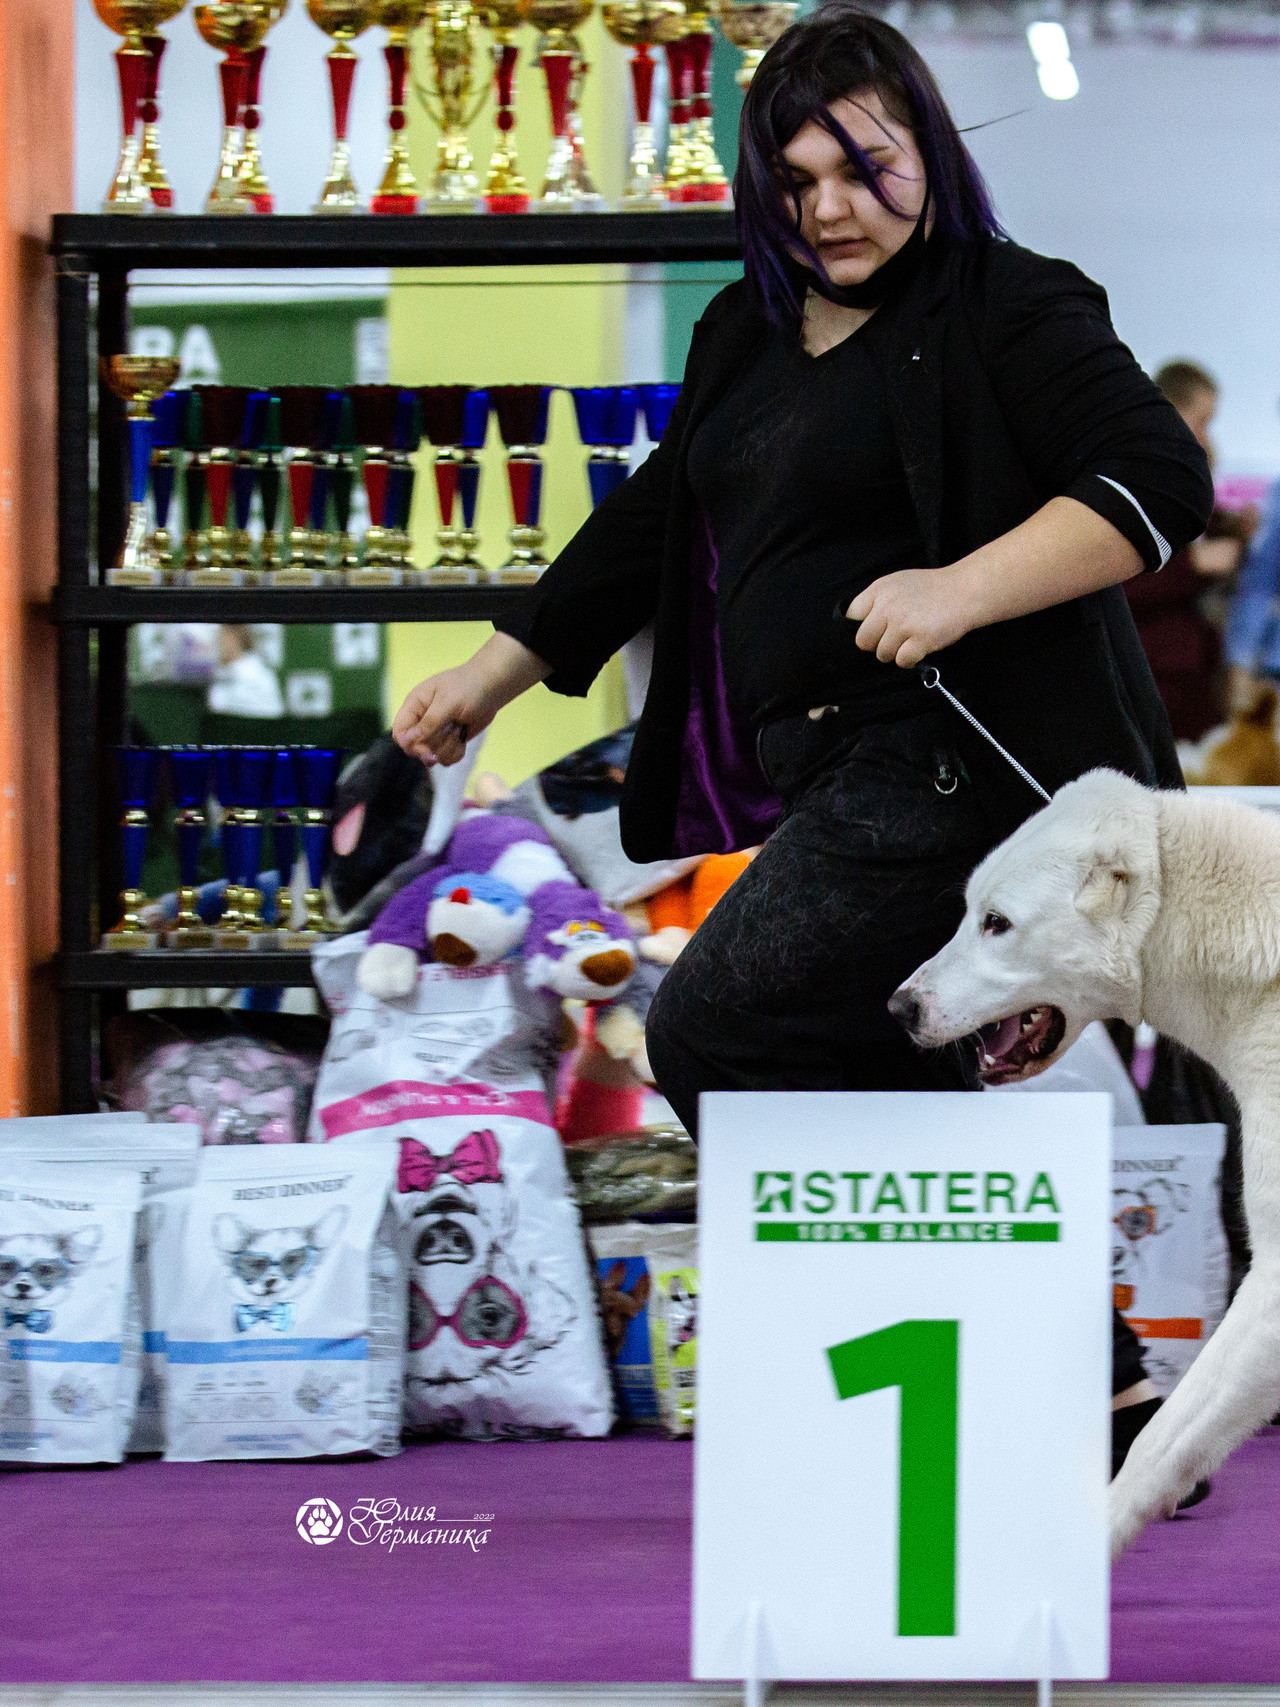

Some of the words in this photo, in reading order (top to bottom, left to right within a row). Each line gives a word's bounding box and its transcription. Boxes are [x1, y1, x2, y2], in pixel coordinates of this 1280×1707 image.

[803, 1170, 1061, 1214] STATERA
[797, 1222, 869, 1241] 100%
[878, 1222, 1014, 1241] BALANCE
[825, 1318, 963, 1638] 1
